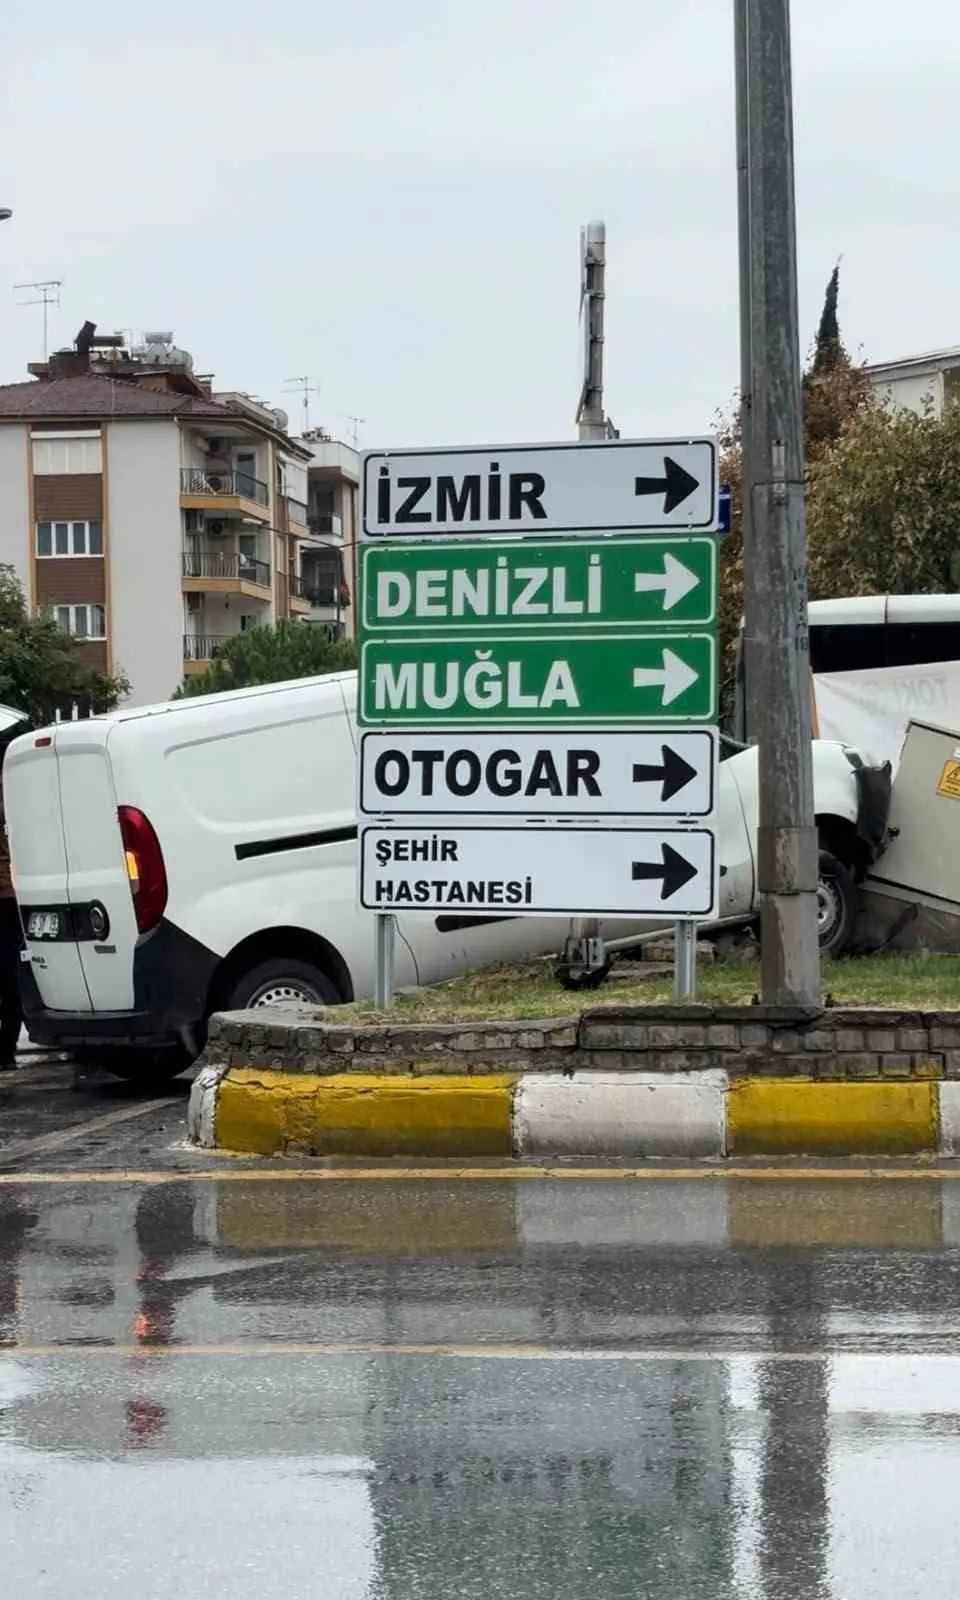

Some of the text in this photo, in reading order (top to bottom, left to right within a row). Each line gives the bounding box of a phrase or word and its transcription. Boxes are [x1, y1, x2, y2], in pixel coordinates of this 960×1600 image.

[377, 461, 548, 525] İZMİR
[377, 553, 602, 618] DENİZLİ
[375, 649, 580, 710] MUĞLA
[374, 748, 602, 797] OTOGAR
[375, 834, 458, 867] ŞEHİR
[375, 876, 532, 904] HASTANESİ
